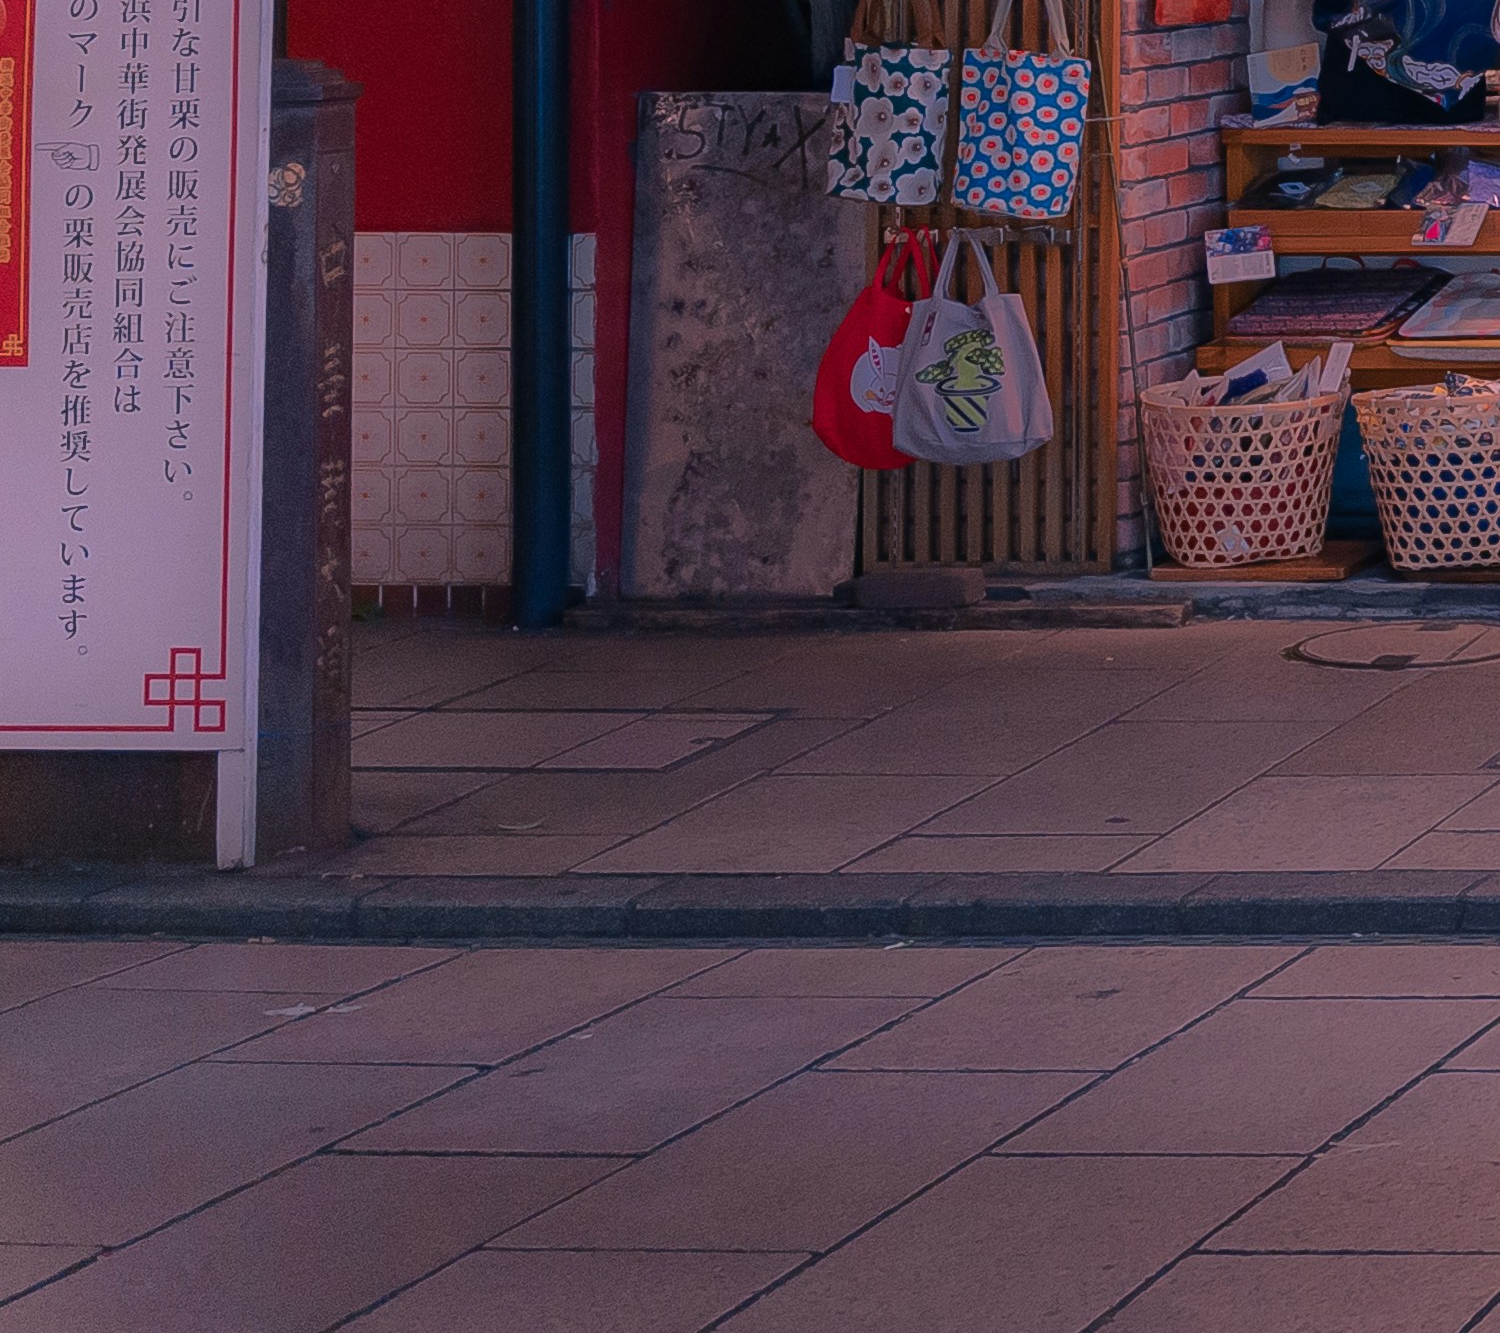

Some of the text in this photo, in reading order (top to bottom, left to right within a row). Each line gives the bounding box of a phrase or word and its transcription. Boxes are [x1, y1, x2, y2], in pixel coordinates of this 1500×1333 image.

[58, 184, 94, 656] の栗販売店を推奨しています。
